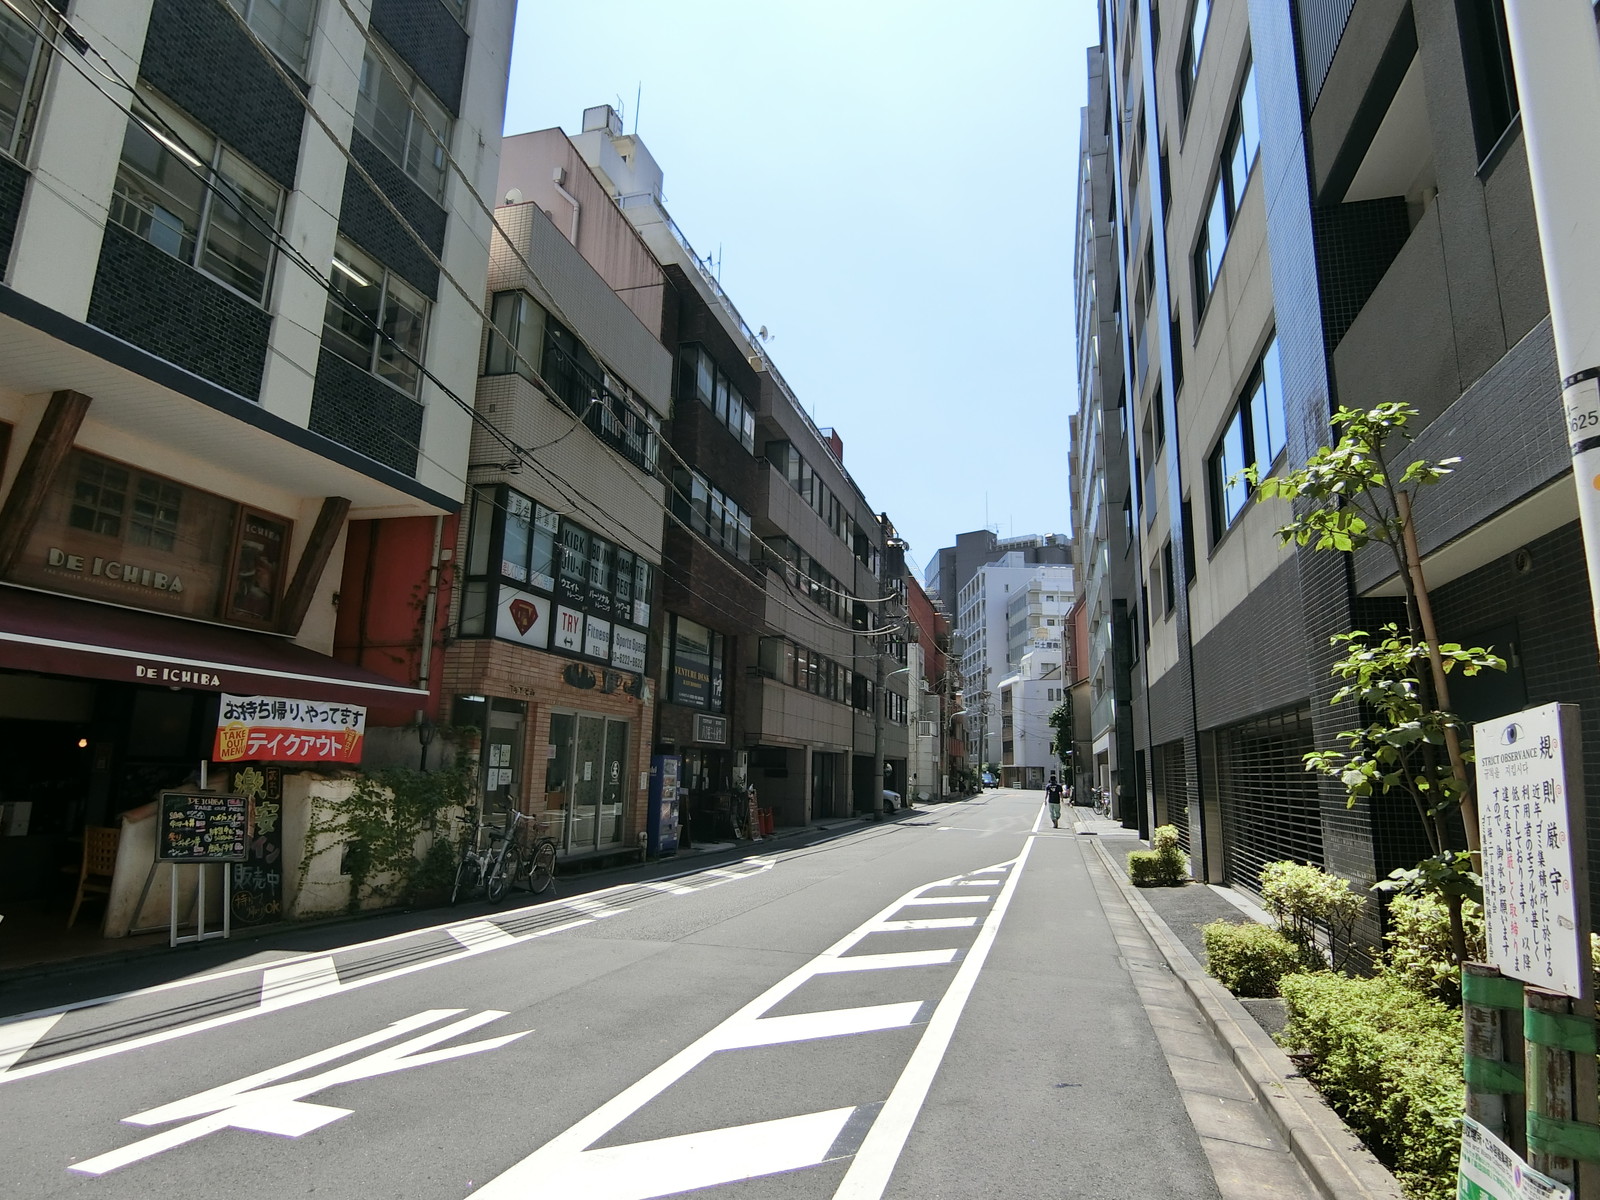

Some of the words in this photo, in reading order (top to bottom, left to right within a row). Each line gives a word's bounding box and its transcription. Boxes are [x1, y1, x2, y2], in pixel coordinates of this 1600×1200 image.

[1569, 410, 1598, 433] 625
[564, 529, 584, 554] KICK
[48, 547, 84, 571] DE
[92, 557, 184, 593] ICHIBA
[562, 612, 579, 634] TRY
[587, 623, 609, 643] Fitness
[592, 645, 601, 657] TEL
[616, 632, 632, 653] Sports
[631, 638, 646, 655] Space
[136, 665, 158, 679] DE
[163, 668, 220, 686] ICHIBA
[223, 700, 364, 727] お持ち帰り、やってます
[223, 729, 246, 741] TAKE
[226, 738, 245, 749] OUT
[248, 732, 343, 757] テイクアウト
[221, 745, 246, 758] MENU
[1481, 755, 1500, 767] STRICT
[1500, 747, 1538, 764] OBSERVANCE
[1540, 735, 1562, 896] 規則厳守
[234, 863, 280, 896] 販売中
